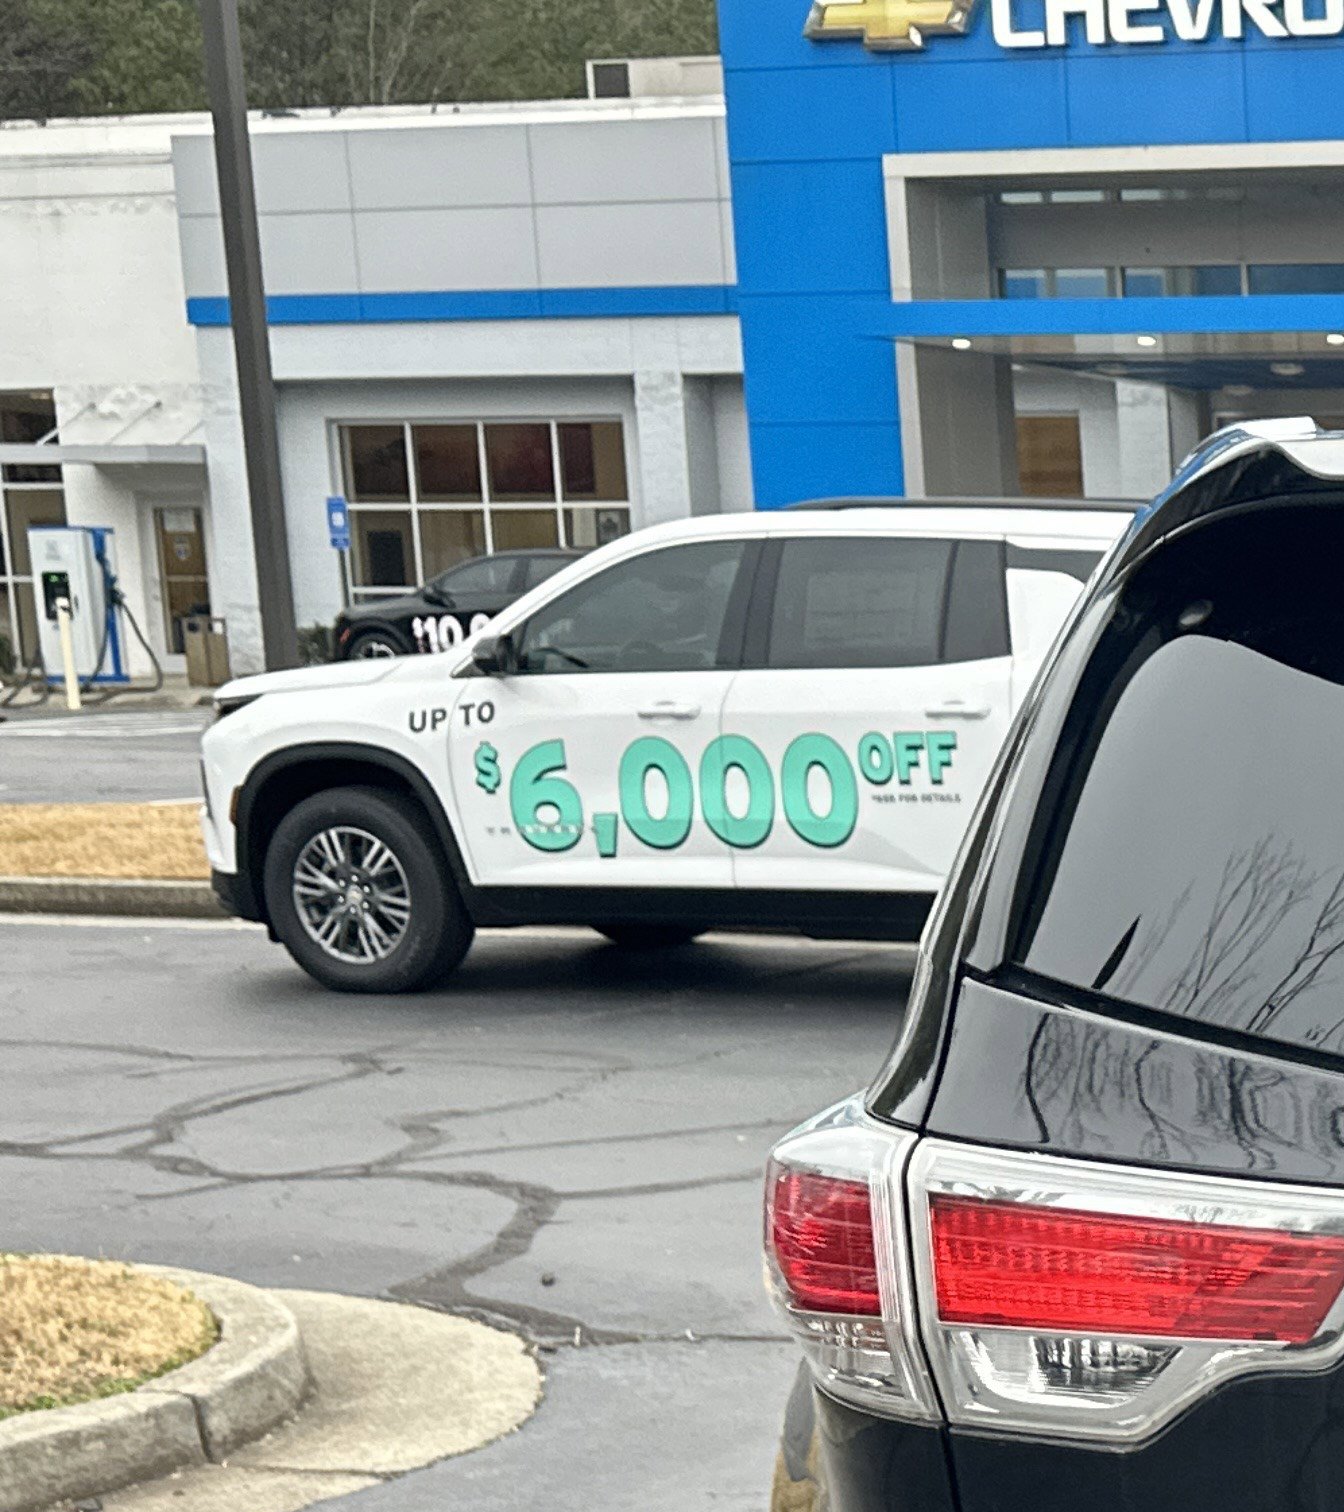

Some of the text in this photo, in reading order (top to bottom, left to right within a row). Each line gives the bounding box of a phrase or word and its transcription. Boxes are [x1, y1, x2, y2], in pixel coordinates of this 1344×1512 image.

[408, 700, 496, 733] UP TO
[858, 730, 957, 786] OFF
